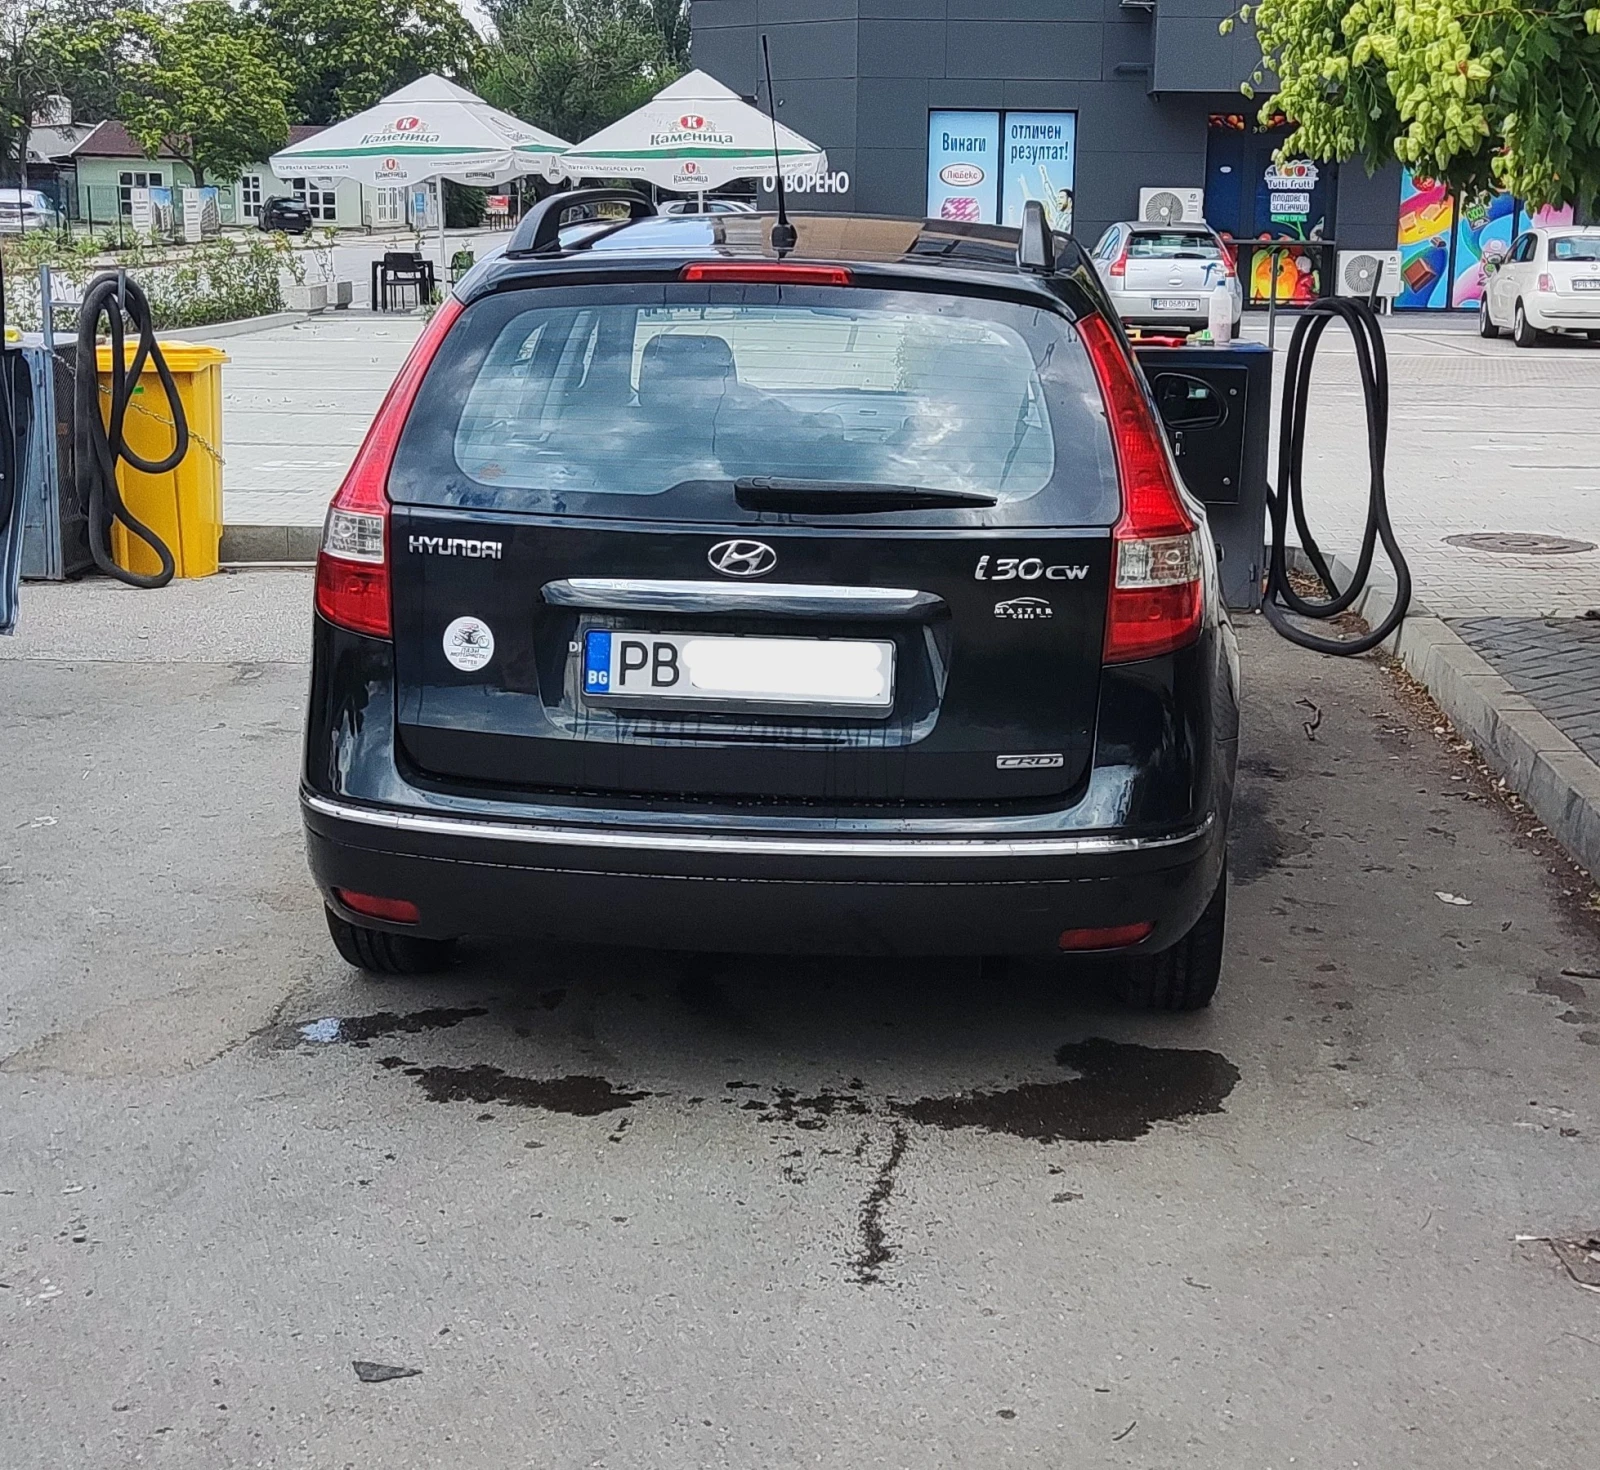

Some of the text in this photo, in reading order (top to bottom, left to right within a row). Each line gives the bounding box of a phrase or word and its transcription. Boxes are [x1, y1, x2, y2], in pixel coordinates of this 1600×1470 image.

[360, 132, 440, 145] Каменица
[650, 131, 733, 145] Каменица
[1011, 124, 1062, 140] отличен
[942, 132, 986, 152] Винаги
[1010, 141, 1069, 166] резултат!
[375, 171, 408, 180] Каменица
[673, 174, 708, 183] Каменица
[763, 171, 850, 193] ОВОРЕНО
[946, 170, 978, 179] Любекс
[409, 535, 503, 560] HYUNDAI
[994, 607, 1054, 615] MASTER
[618, 640, 680, 687] PB
[588, 670, 608, 685] BG
